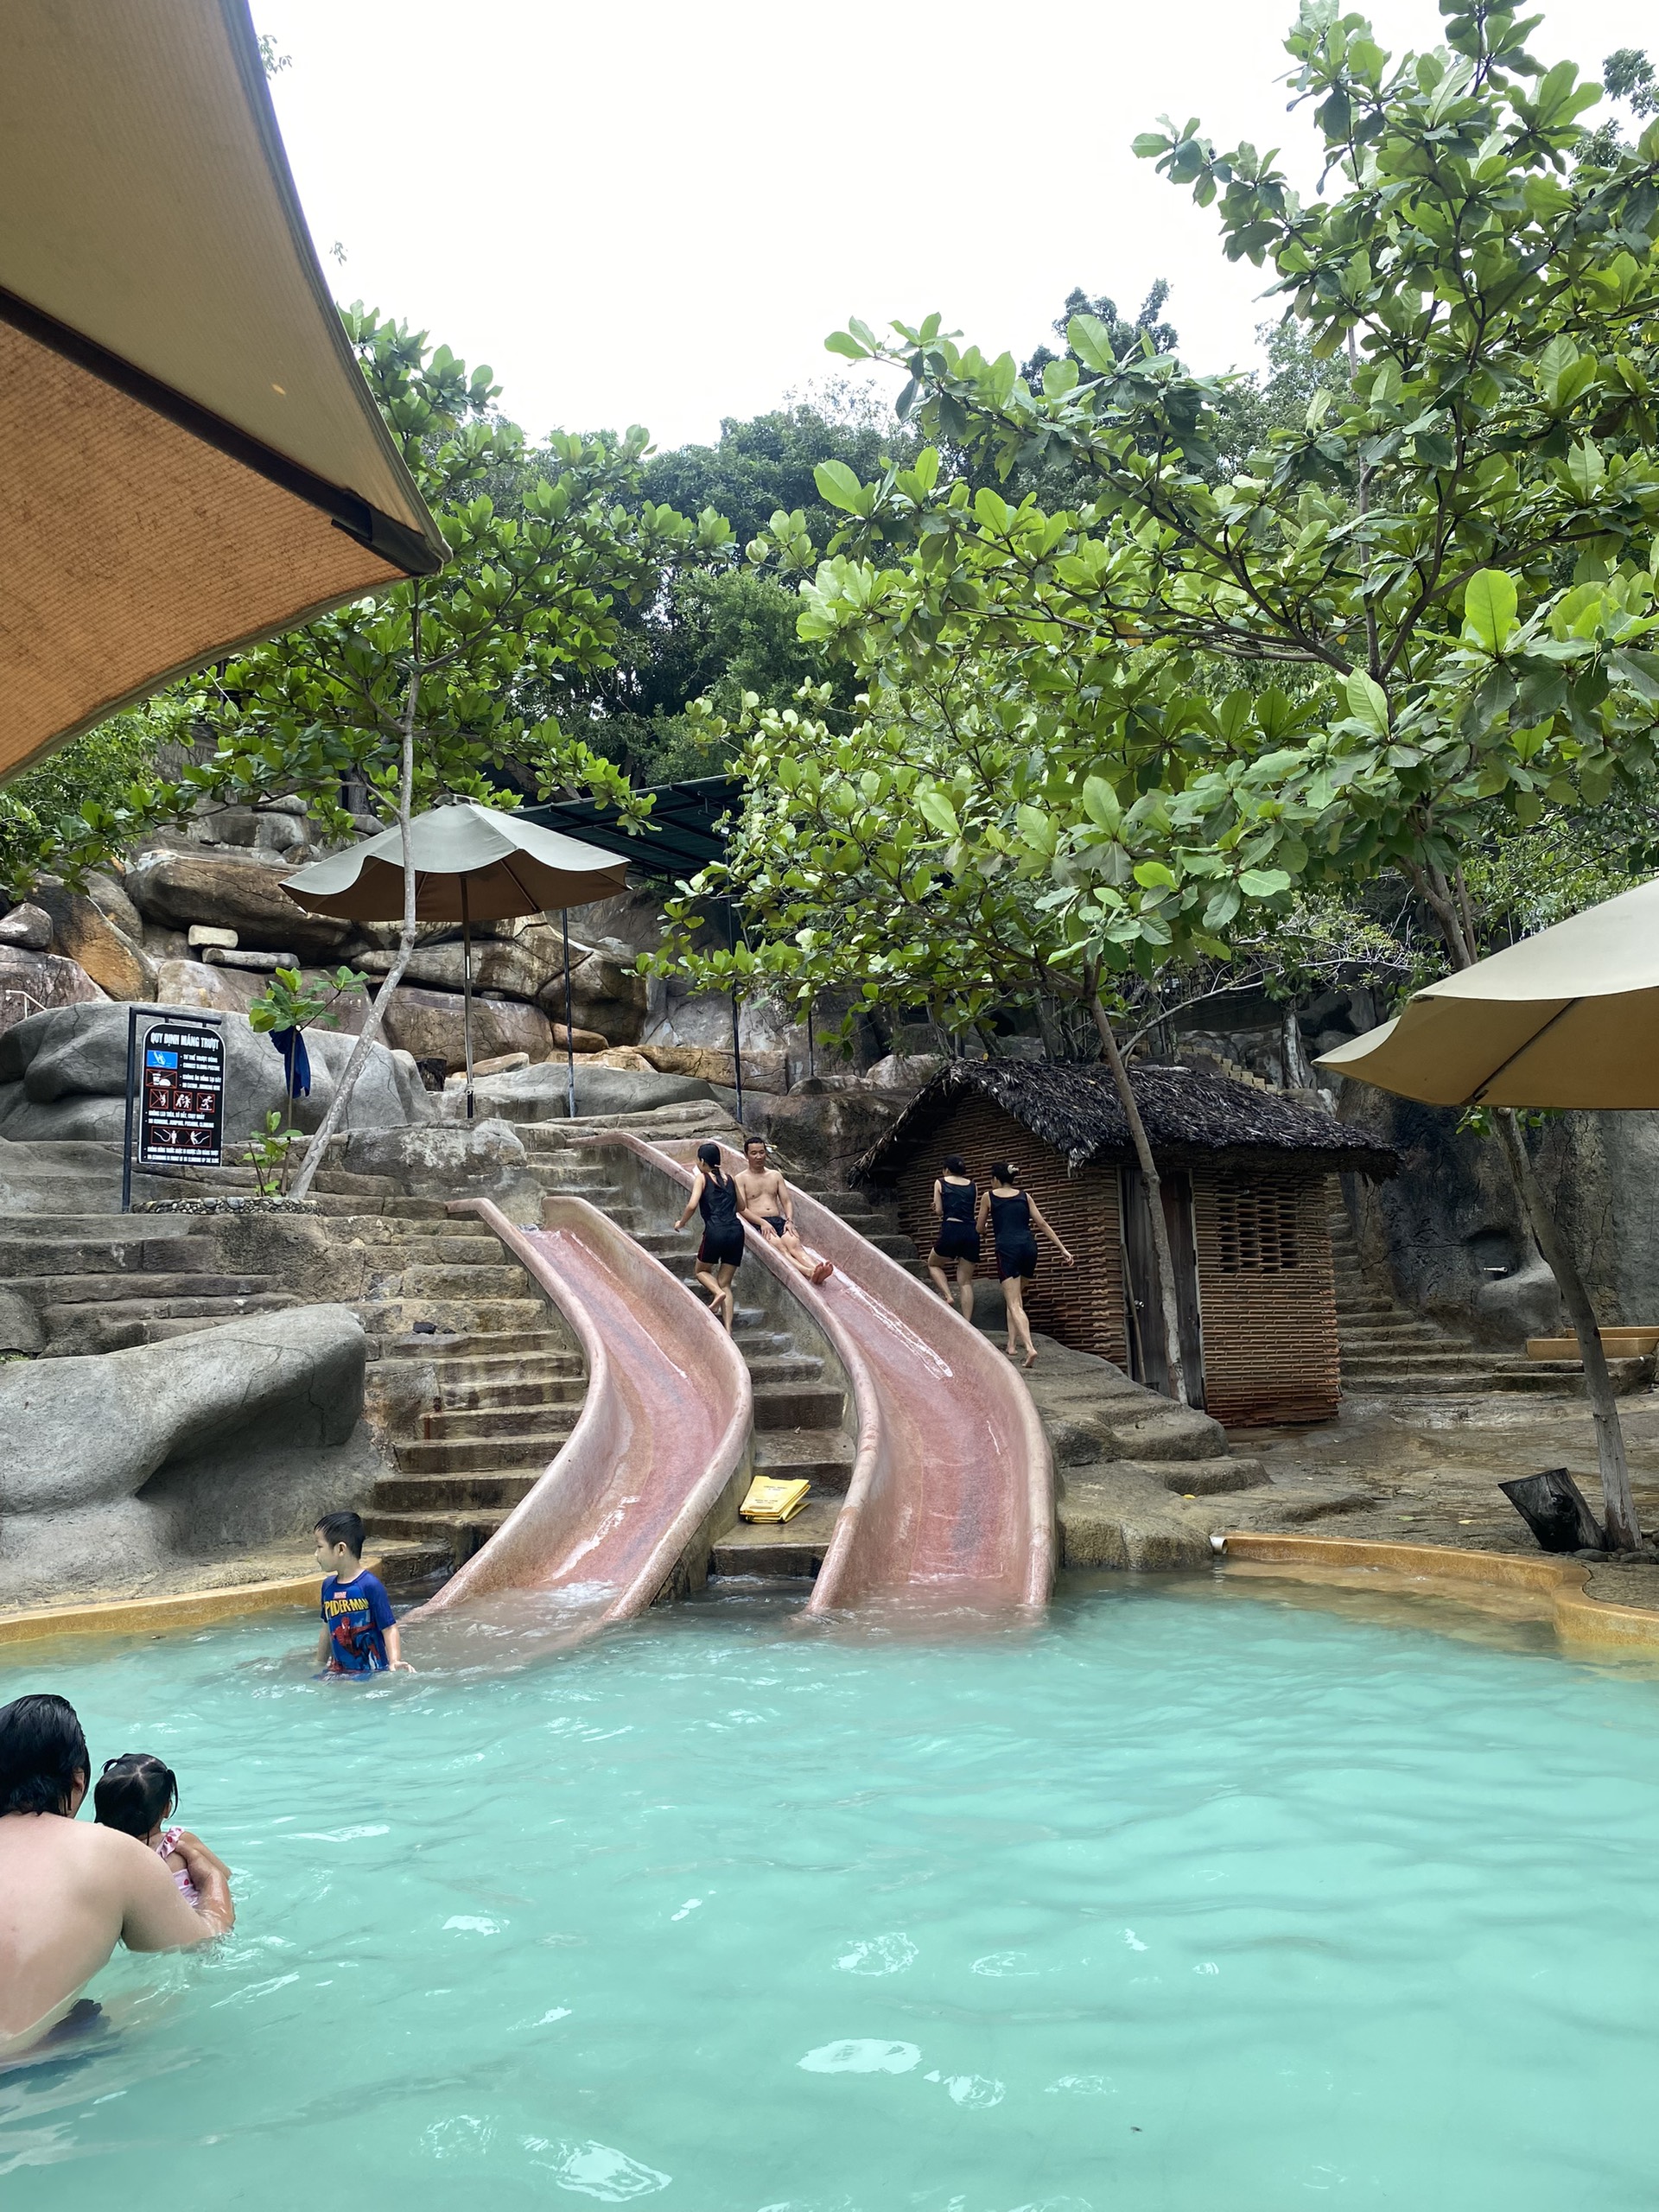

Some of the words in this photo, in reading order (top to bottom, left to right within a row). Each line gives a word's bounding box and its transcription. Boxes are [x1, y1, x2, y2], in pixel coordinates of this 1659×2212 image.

[150, 1032, 163, 1044] QUY
[163, 1033, 180, 1046] ĐỊNH
[324, 1598, 369, 1620] PIDER-MAN
